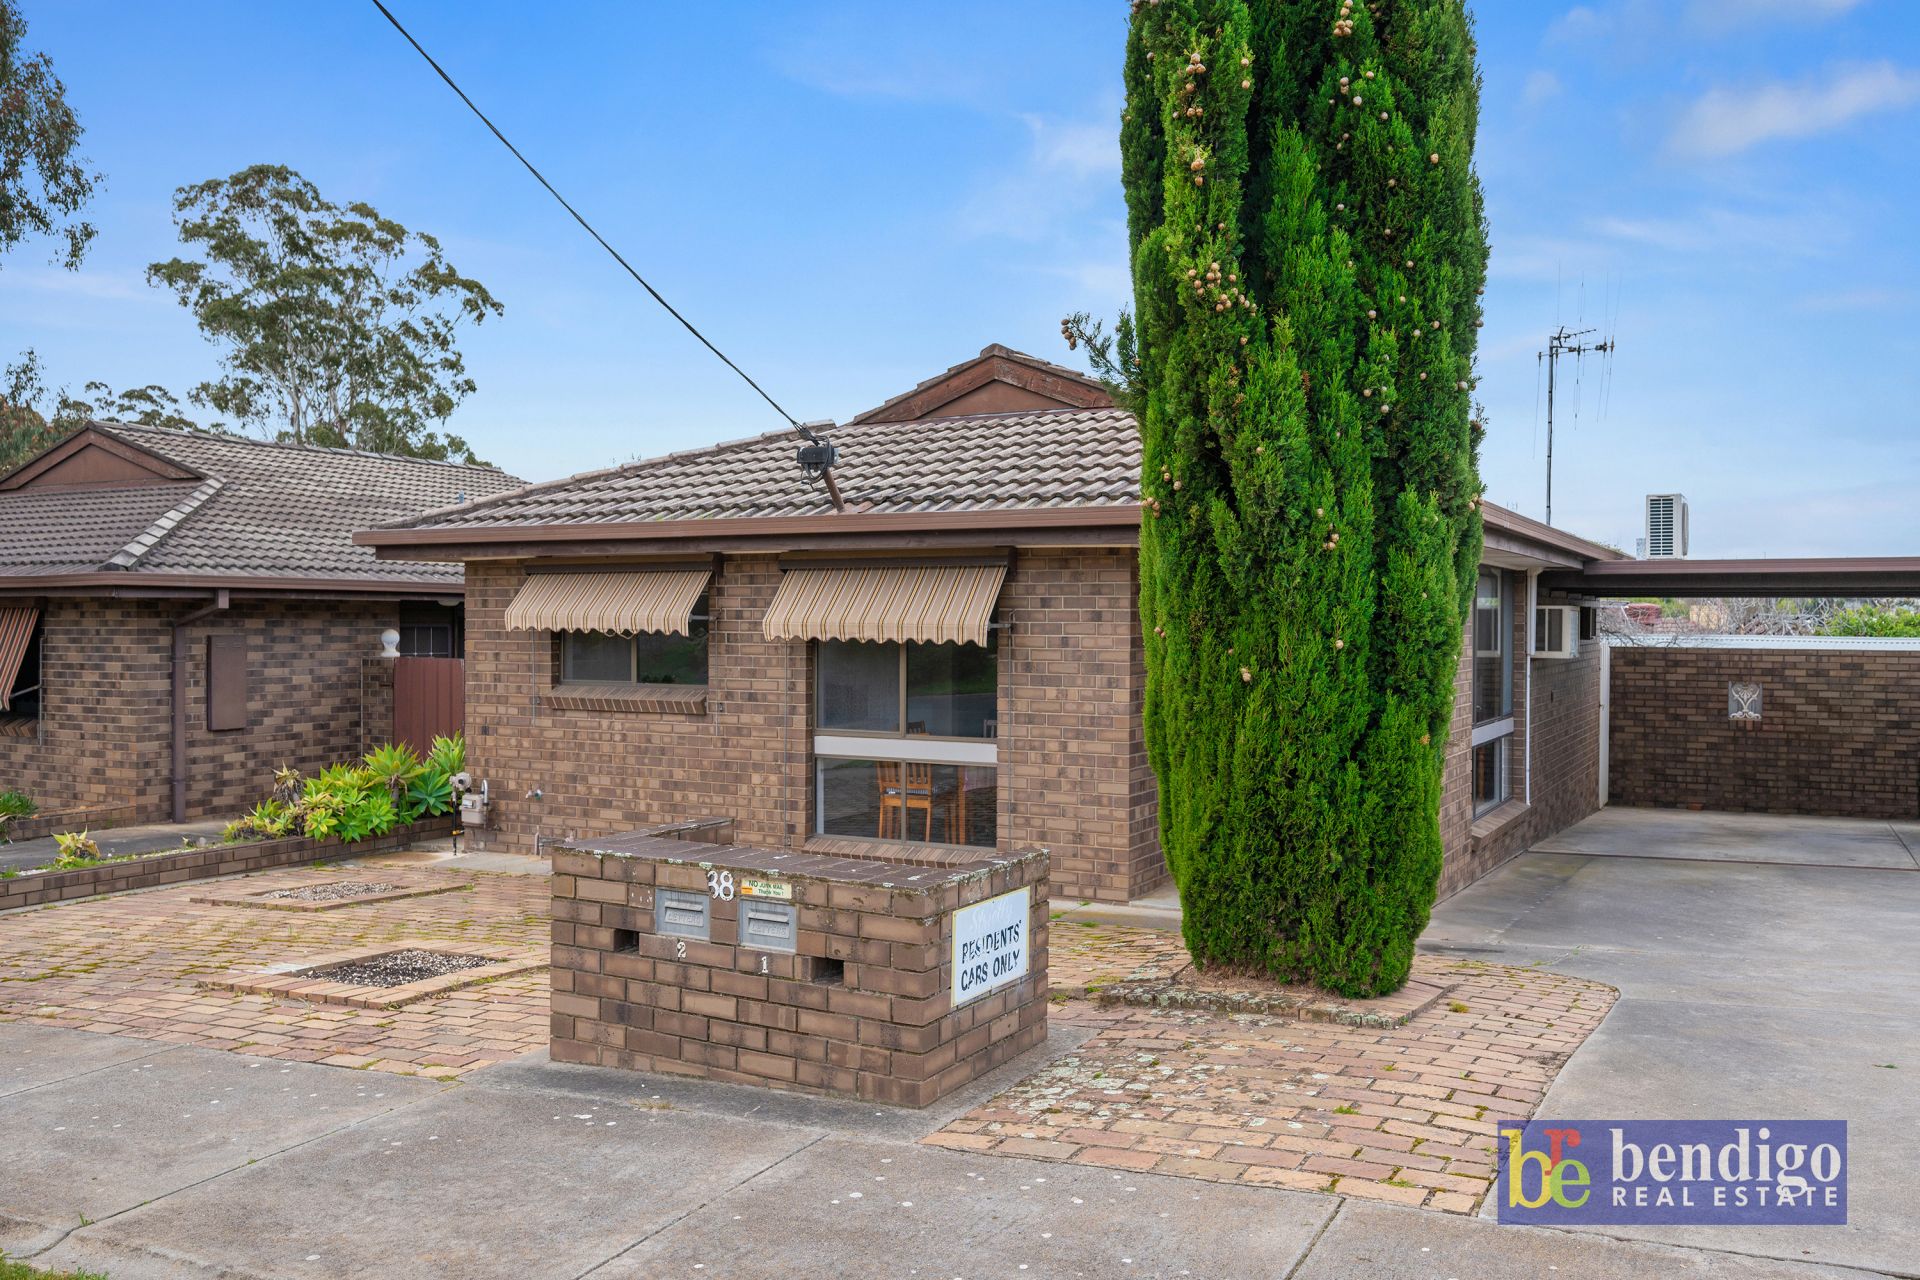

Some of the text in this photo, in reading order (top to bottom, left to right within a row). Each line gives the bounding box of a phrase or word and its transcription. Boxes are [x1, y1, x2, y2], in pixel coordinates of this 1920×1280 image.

[707, 870, 735, 902] 38
[748, 879, 758, 888] NO
[676, 941, 687, 959] 2
[760, 956, 769, 973] 1
[960, 949, 1020, 992] CARS ONLY
